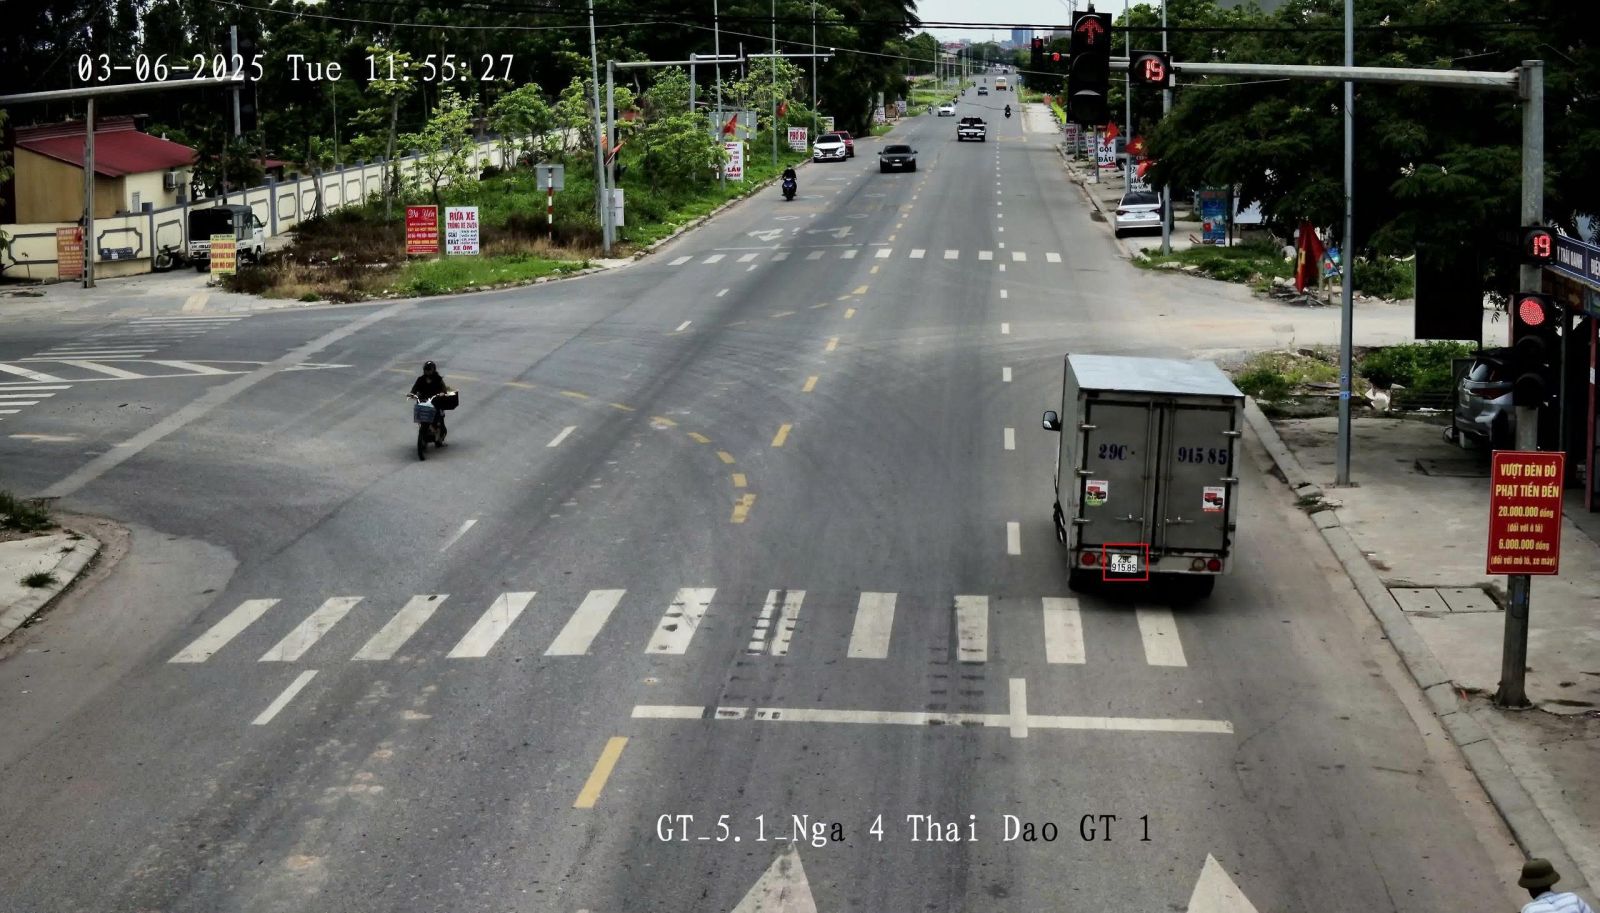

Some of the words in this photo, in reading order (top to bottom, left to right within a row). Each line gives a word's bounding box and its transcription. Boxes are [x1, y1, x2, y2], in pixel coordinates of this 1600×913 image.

[449, 208, 464, 221] RỬA
[466, 211, 475, 221] XE
[1533, 235, 1551, 257] 19
[1500, 463, 1523, 479] VƯỢT
[1524, 462, 1542, 477] ĐÈN
[1544, 461, 1556, 477] ĐỎ
[1495, 484, 1518, 500] PHẠT
[1541, 481, 1559, 498] ĐẾN
[1498, 505, 1539, 517] 20.000.000
[1498, 538, 1535, 550] 6.000.000
